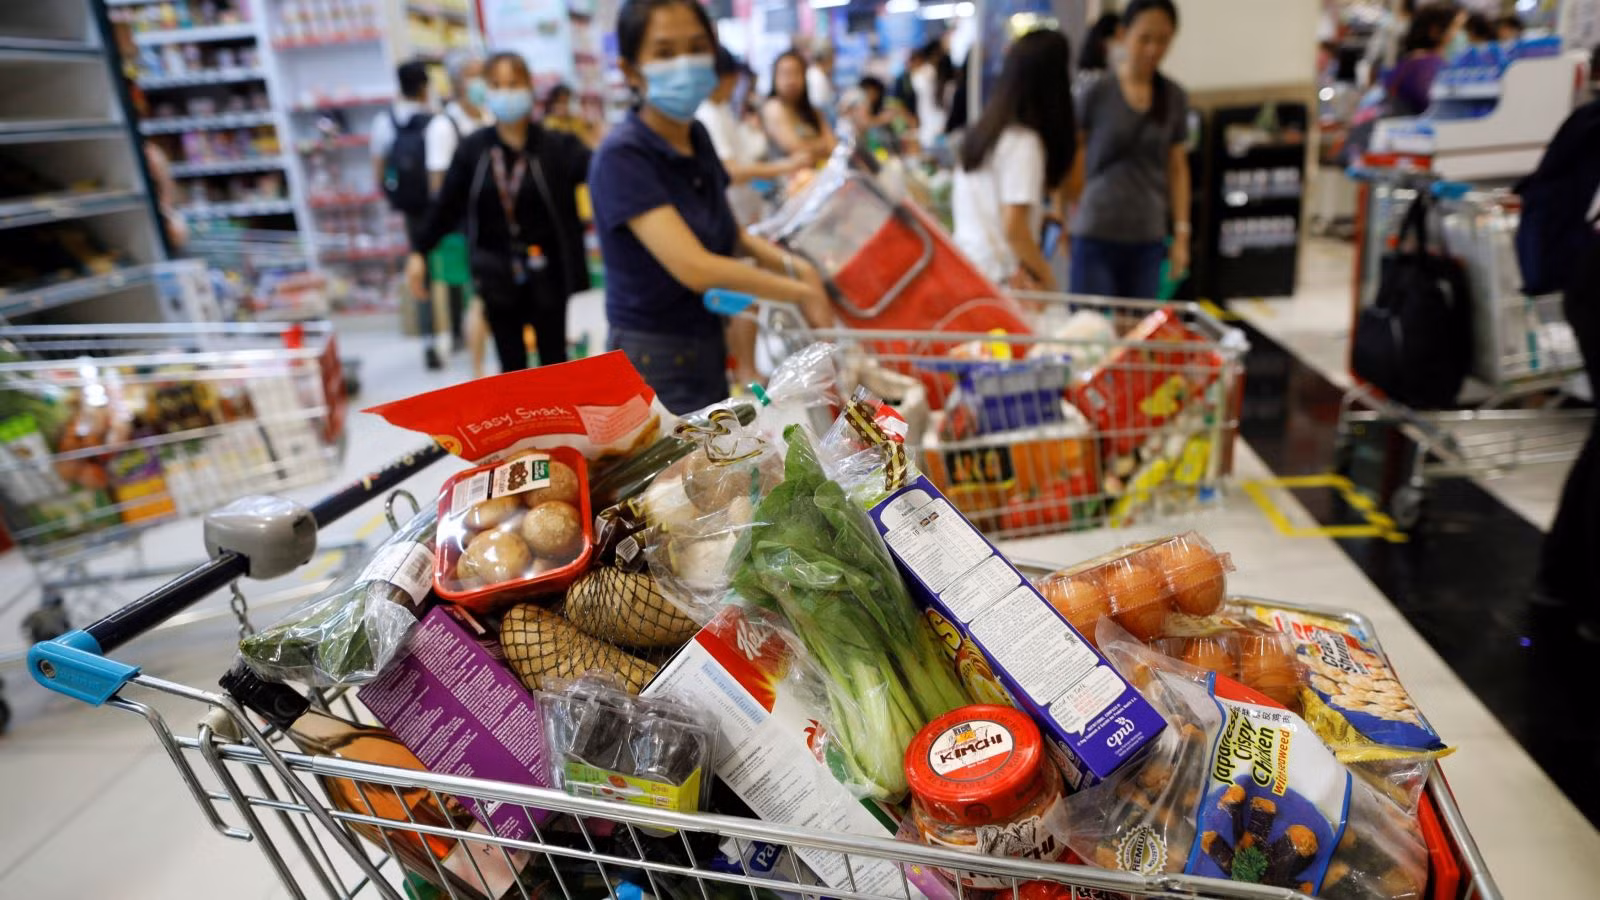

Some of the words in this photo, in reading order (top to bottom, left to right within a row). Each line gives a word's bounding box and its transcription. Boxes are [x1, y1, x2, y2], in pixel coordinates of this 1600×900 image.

[466, 412, 513, 434] Easy
[515, 406, 571, 420] Snack
[940, 734, 1003, 764] KIMCHI
[1213, 707, 1239, 785] Japanese
[1233, 717, 1257, 760] Crispy
[1252, 727, 1274, 785] Chicken
